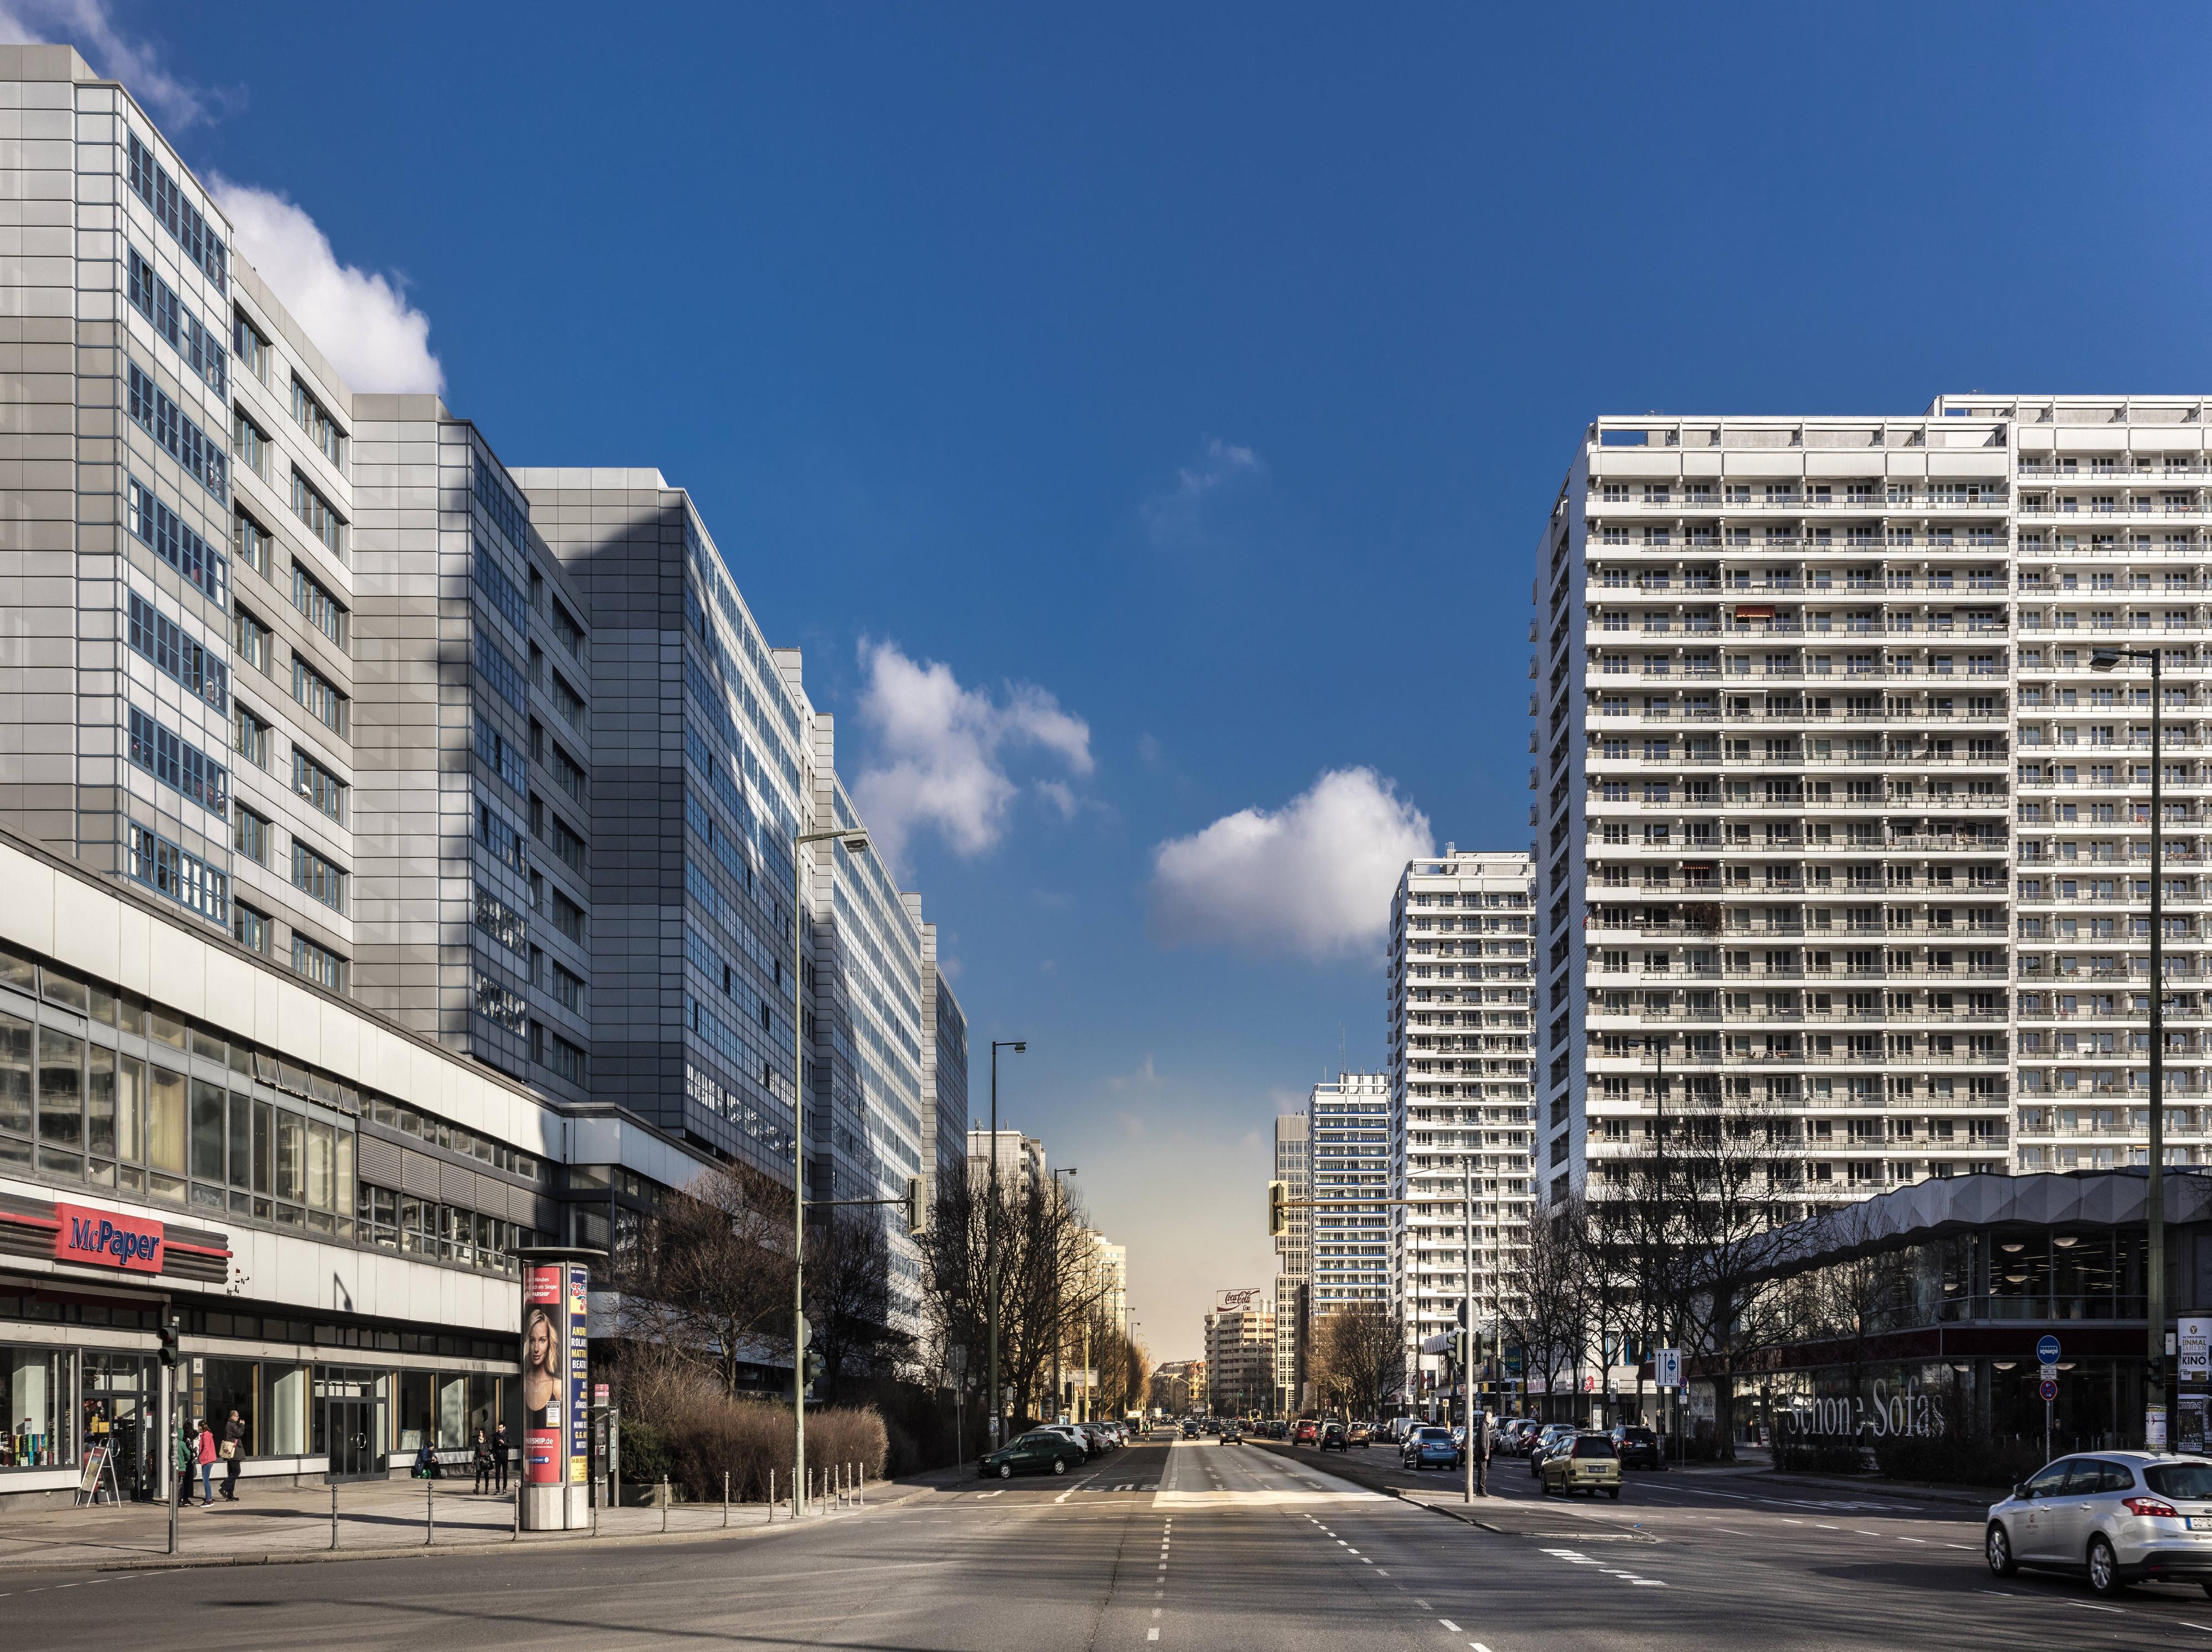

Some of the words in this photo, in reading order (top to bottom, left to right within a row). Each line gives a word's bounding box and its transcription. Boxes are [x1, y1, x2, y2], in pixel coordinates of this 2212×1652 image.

[69, 1216, 160, 1265] McPaper
[1225, 1291, 1251, 1305] Coca-Cola
[2182, 1356, 2206, 1365] KINO
[1872, 1374, 1946, 1437] Sofas
